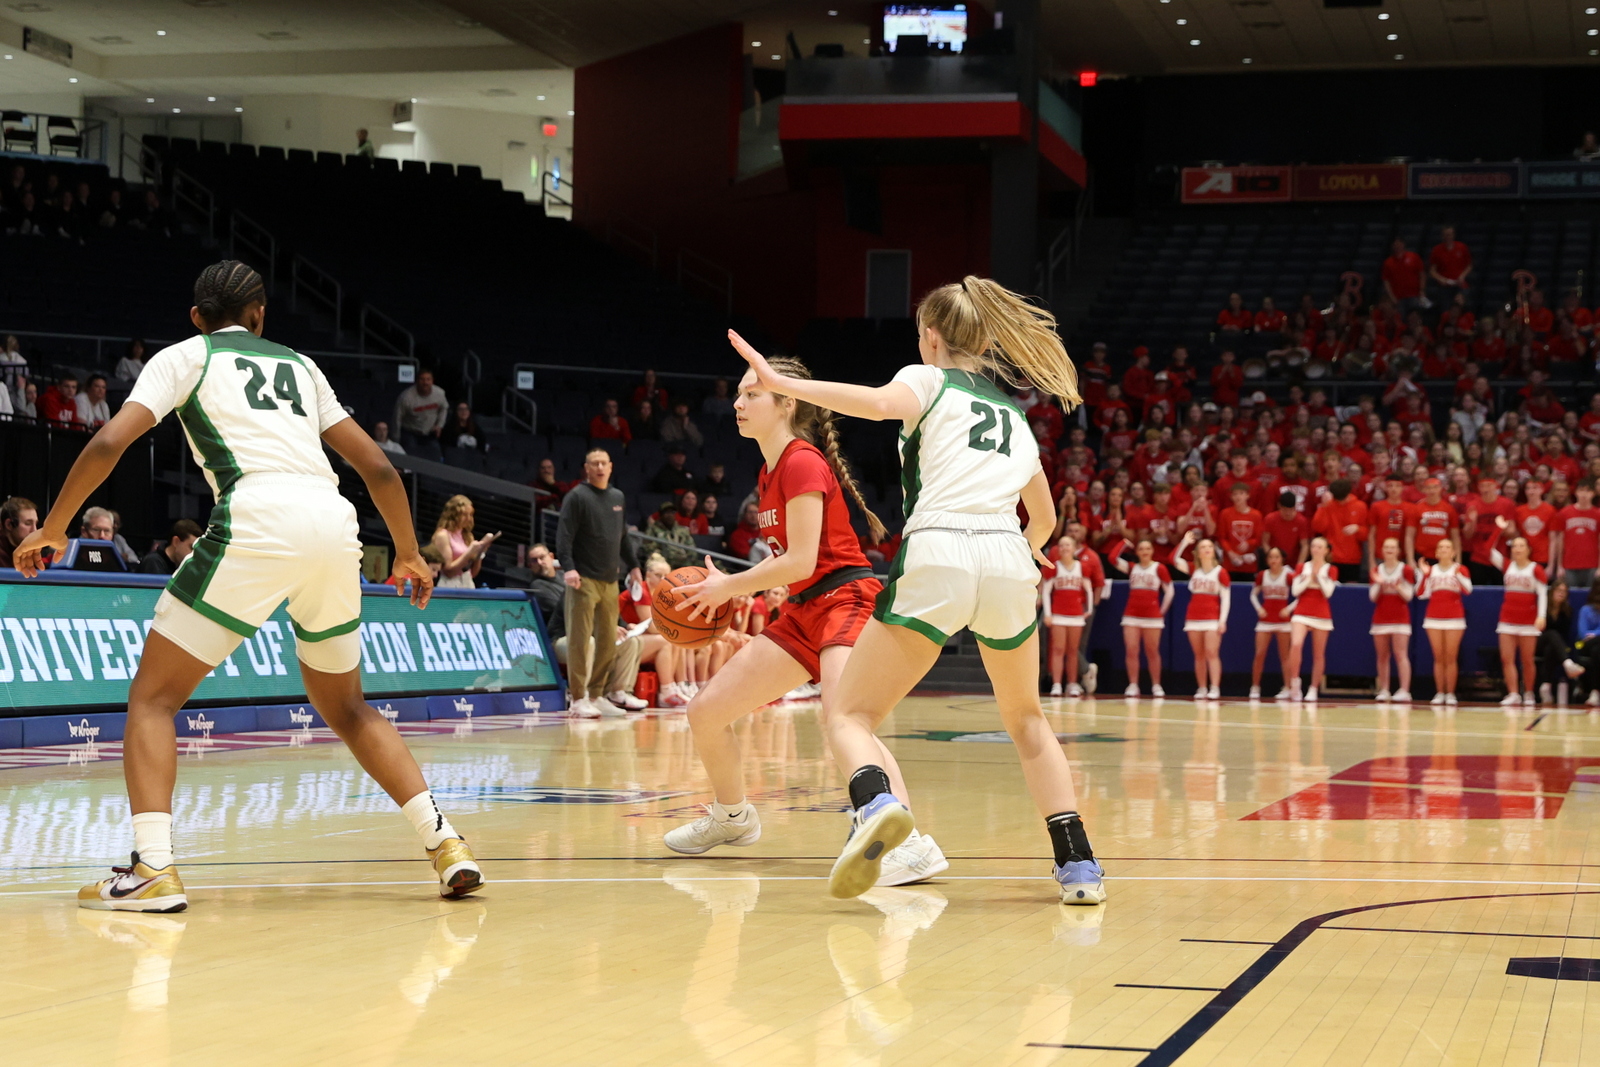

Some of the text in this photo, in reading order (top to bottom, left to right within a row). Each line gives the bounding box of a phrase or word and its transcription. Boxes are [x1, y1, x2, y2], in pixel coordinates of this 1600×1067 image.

[1319, 174, 1380, 190] LOYOLA
[234, 357, 308, 417] 24
[968, 401, 1012, 458] 21
[88, 551, 102, 563] POSS
[244, 621, 288, 676] OF
[416, 622, 512, 672] ARENA
[505, 628, 544, 659] OHSAA
[196, 713, 215, 732] Kroger
[297, 707, 314, 724] Kroger
[78, 718, 100, 740] Kroger
